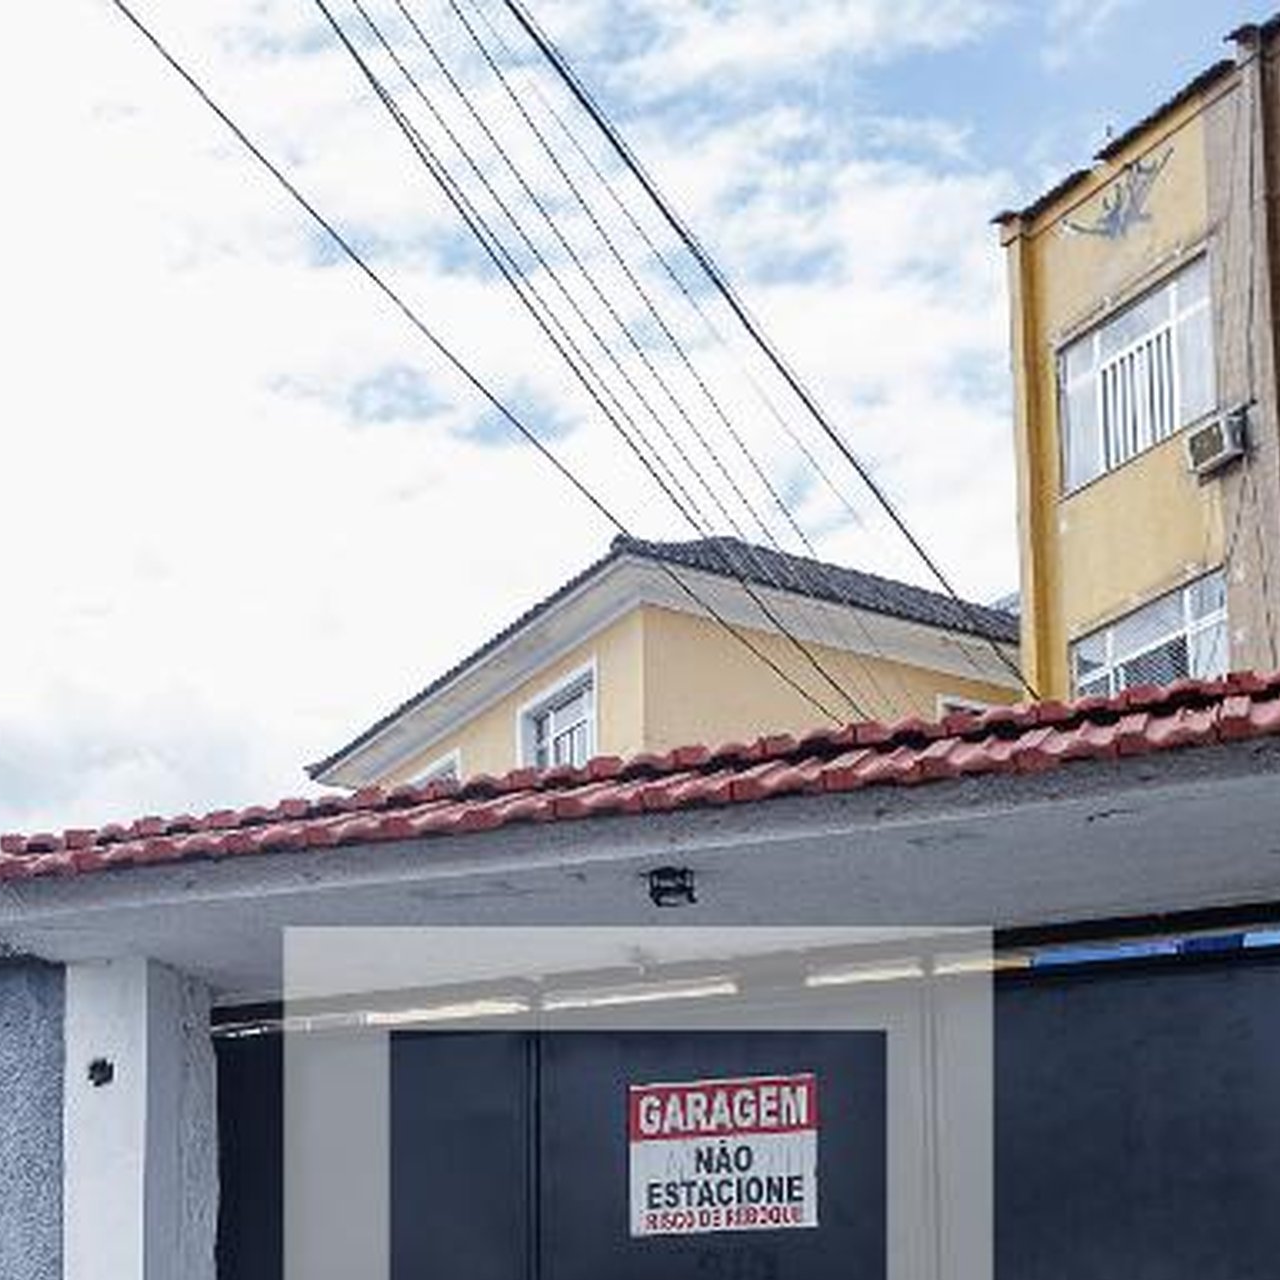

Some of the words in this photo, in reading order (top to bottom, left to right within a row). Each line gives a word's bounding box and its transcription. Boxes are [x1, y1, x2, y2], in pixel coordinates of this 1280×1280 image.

[639, 1086, 807, 1134] GARAGEM
[695, 1140, 752, 1174] NÃO
[646, 1176, 804, 1209] ESTACIONE
[699, 1209, 721, 1228] DE
